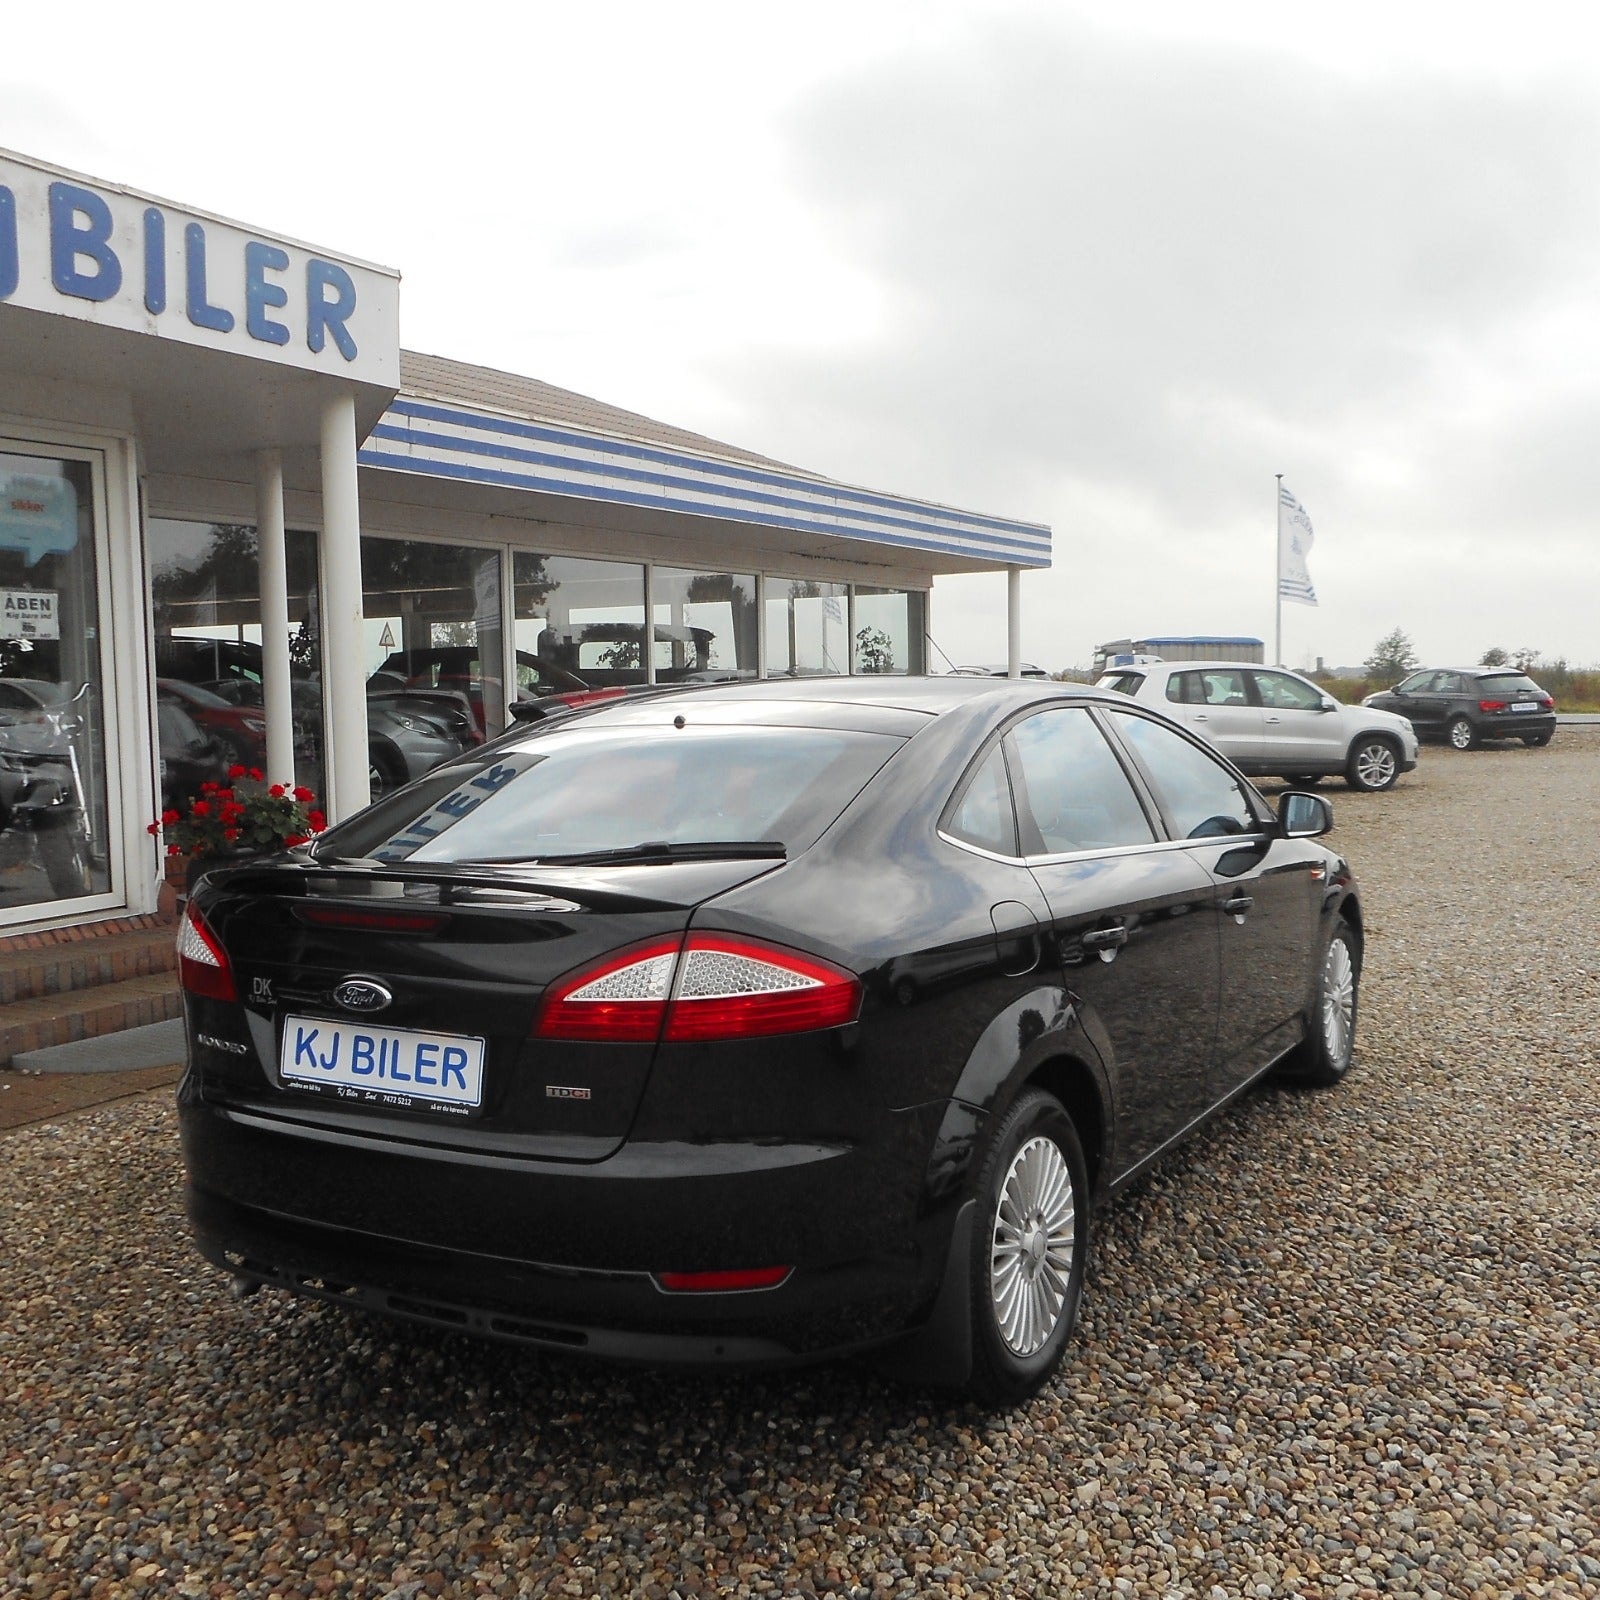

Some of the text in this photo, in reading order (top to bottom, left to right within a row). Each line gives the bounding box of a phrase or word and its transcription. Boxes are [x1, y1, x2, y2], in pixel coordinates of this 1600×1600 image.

[48, 181, 358, 361] BILER
[5, 593, 51, 611] ÅBEN
[253, 977, 272, 997] DK
[343, 986, 376, 1005] Ford
[295, 1027, 468, 1090] KJ BILER
[383, 1094, 397, 1104] 7472
[397, 1096, 412, 1106] 5212
